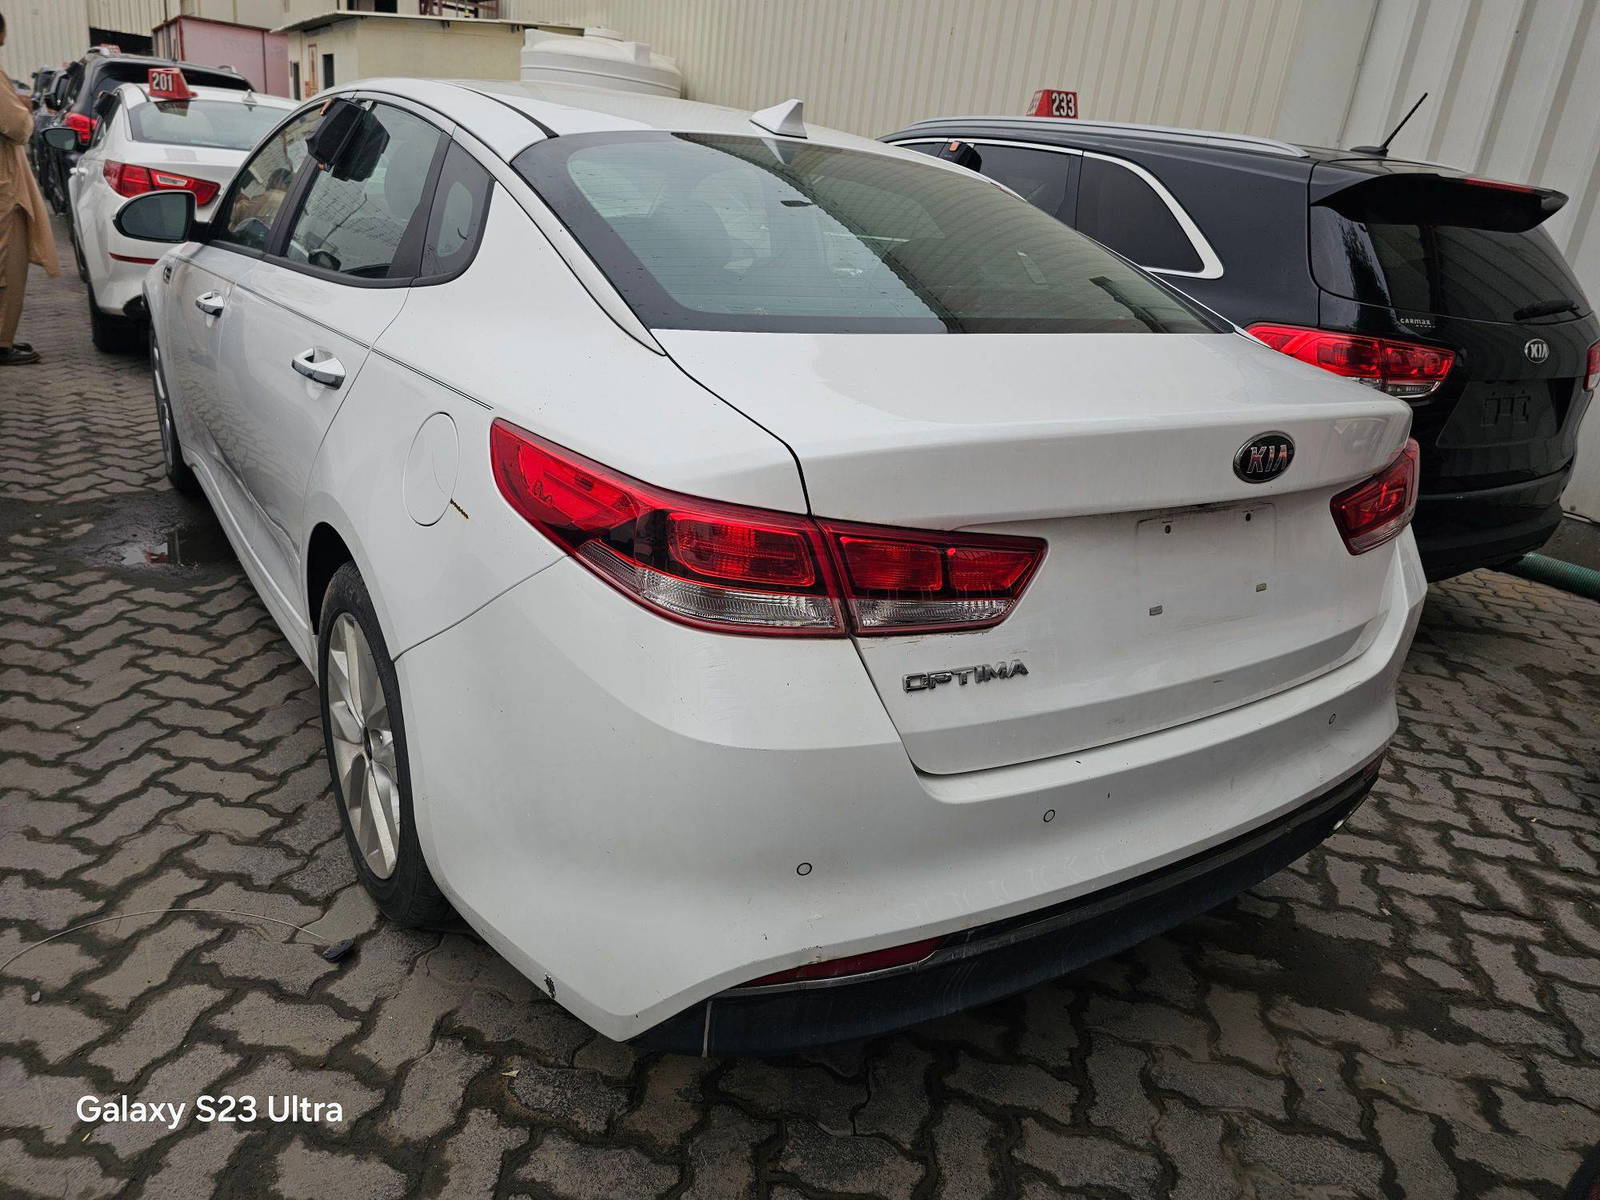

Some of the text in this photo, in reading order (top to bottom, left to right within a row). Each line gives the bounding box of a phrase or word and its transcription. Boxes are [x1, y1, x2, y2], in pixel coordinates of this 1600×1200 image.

[152, 72, 173, 91] 201
[1052, 92, 1075, 117] 233
[1530, 343, 1549, 358] KIA
[1247, 444, 1288, 474] KIA
[902, 659, 1029, 693] OPTIMA
